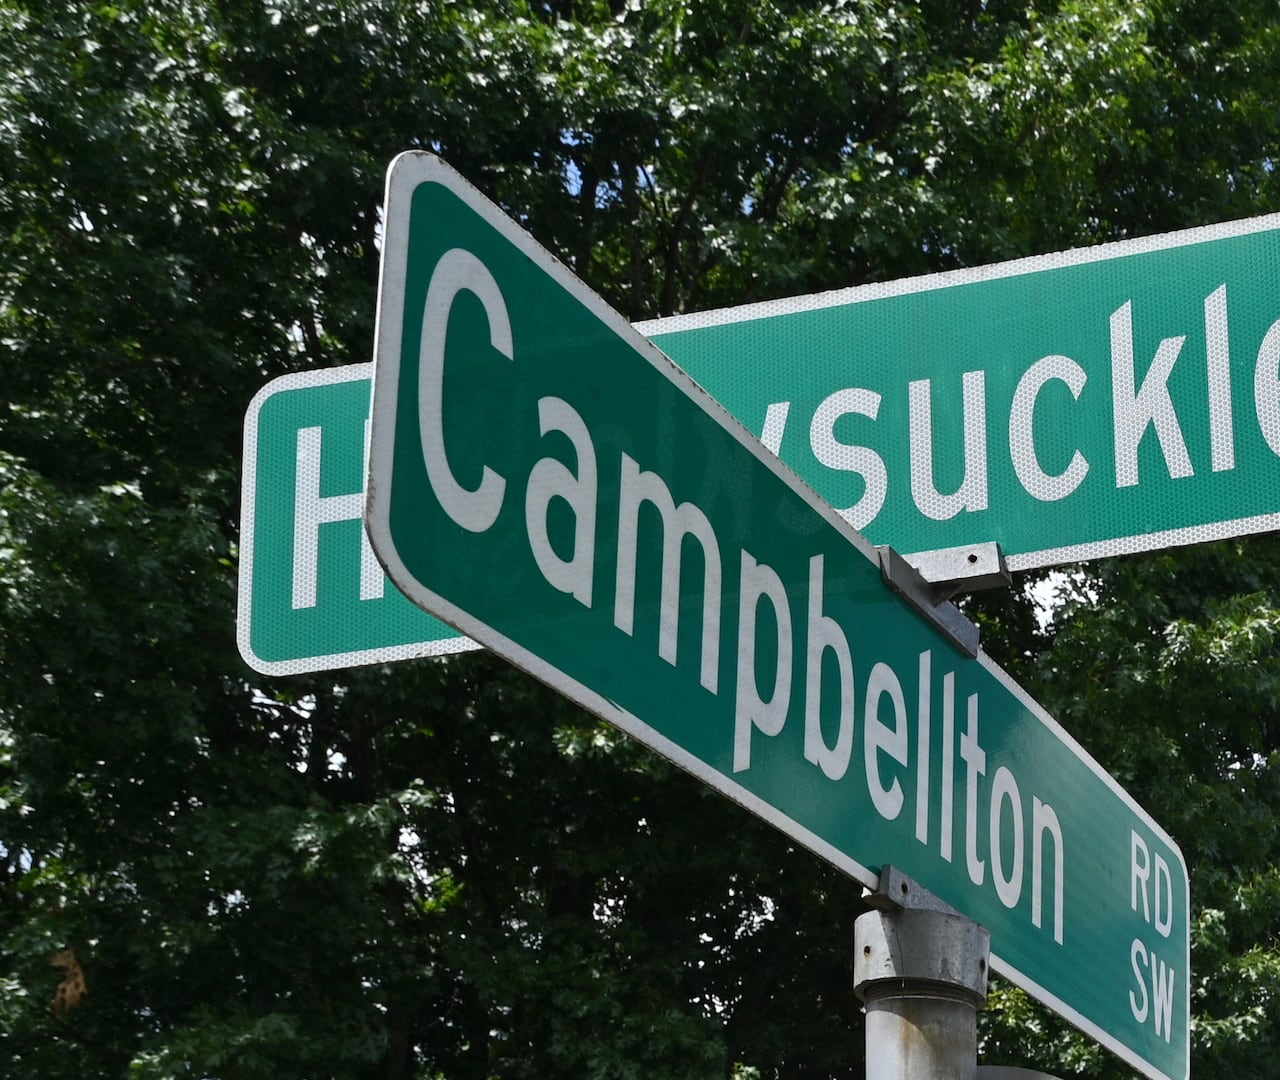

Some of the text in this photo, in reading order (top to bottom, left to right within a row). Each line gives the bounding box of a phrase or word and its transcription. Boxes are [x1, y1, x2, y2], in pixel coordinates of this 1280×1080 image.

[418, 248, 1064, 946] Campbellton
[1130, 828, 1173, 938] RD
[1128, 938, 1175, 1045] SW
